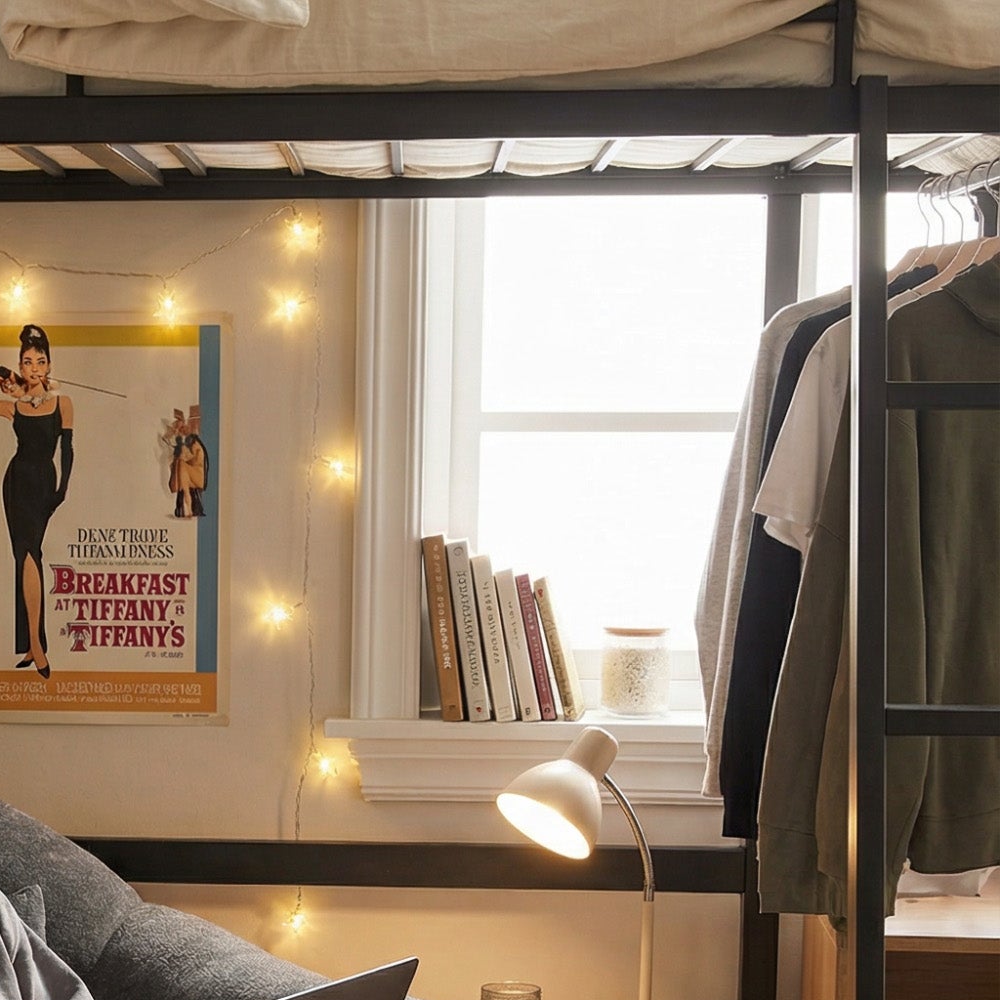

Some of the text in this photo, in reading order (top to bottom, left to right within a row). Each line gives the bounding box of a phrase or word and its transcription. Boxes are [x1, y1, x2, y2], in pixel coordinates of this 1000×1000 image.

[49, 564, 191, 596] BREAKFAST
[54, 598, 71, 611] AT
[72, 598, 172, 621] TIFFANY
[67, 620, 186, 652] TIFFANY'S
